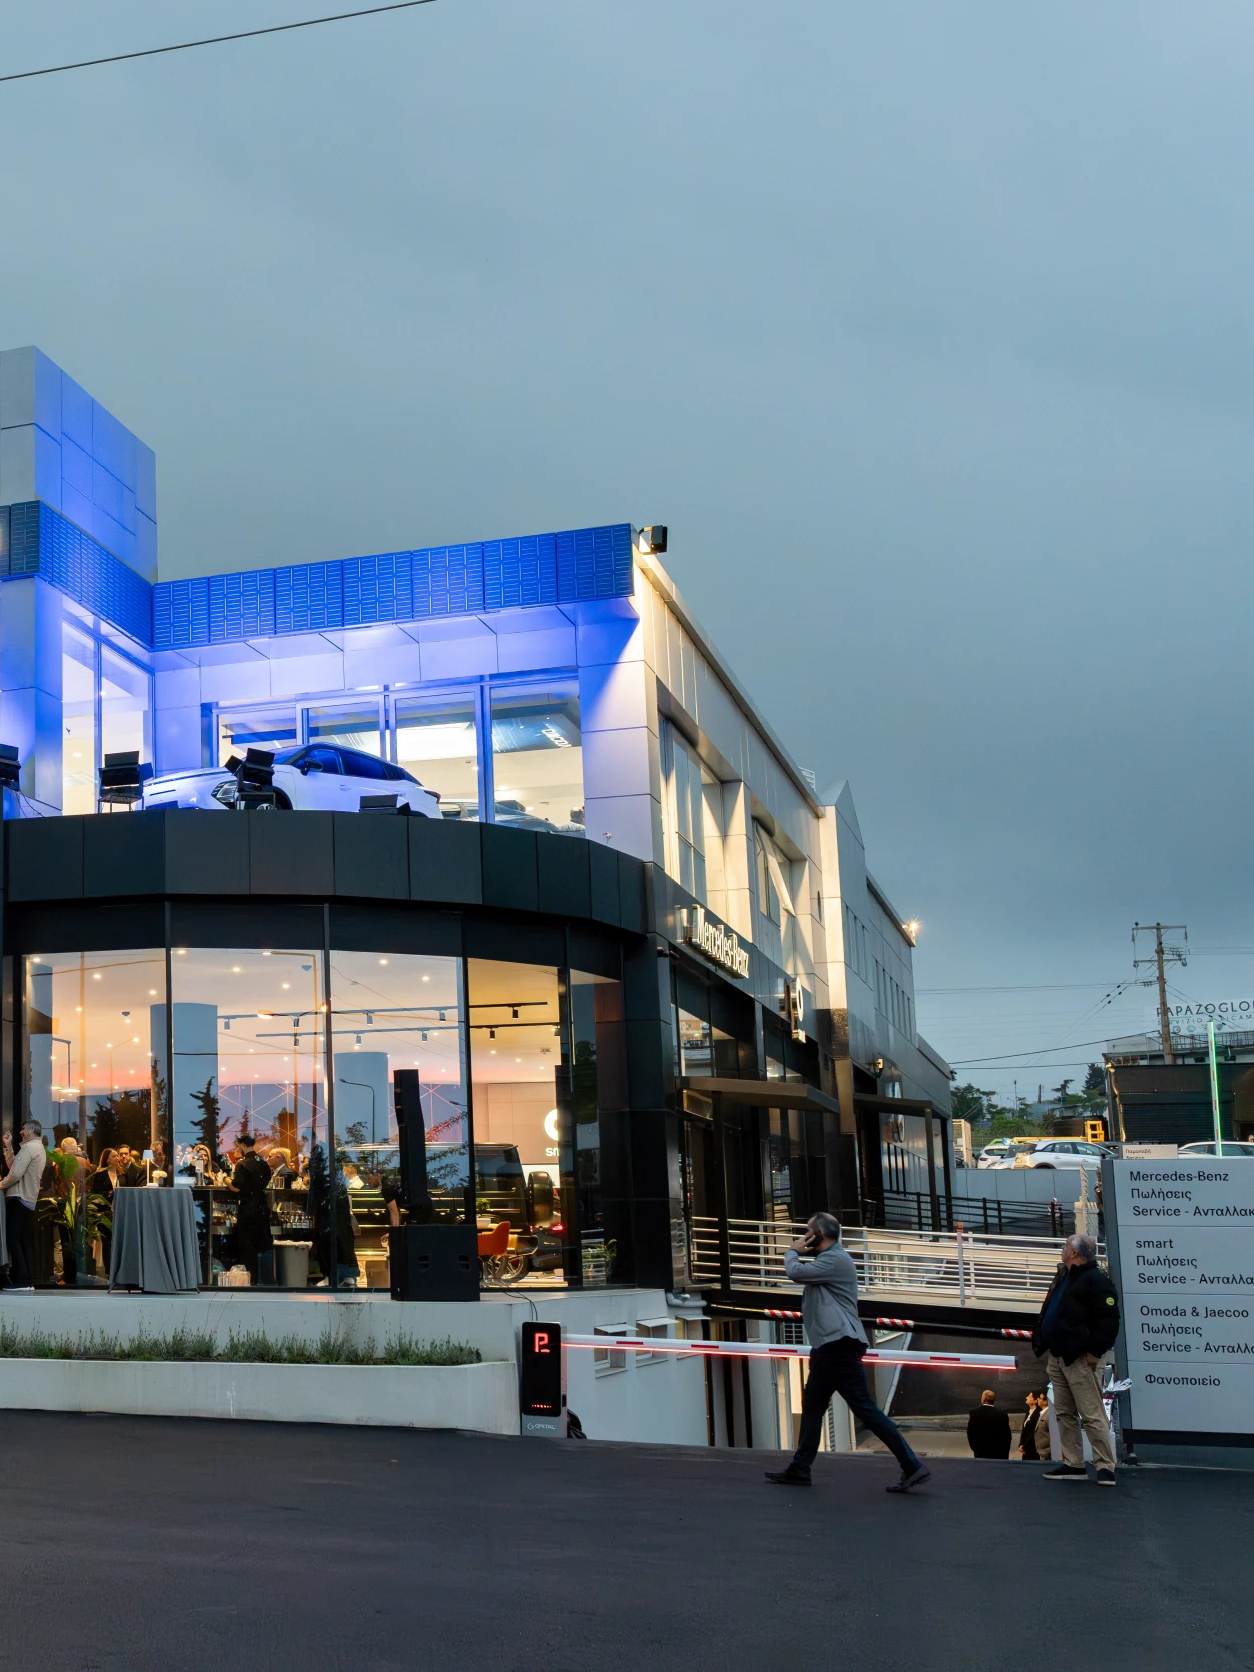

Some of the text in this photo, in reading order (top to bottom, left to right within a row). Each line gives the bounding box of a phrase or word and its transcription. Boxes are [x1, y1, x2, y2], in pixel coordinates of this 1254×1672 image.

[692, 903, 750, 979] Mercedes-Benz
[1129, 1170, 1229, 1182] Mercedes-Benz
[1131, 1187, 1192, 1202] Πωλήσεις
[1132, 1205, 1181, 1217] Service
[1135, 1238, 1174, 1249] smart
[1136, 1254, 1198, 1269] Πωλήσεις
[1138, 1272, 1187, 1284] Service
[1199, 1273, 1254, 1285] Ανταλλα
[1140, 1305, 1249, 1319] Omoda & Jaecoo
[1141, 1322, 1203, 1338] Πωλήσεις
[1142, 1340, 1192, 1353] Service
[1144, 1373, 1221, 1387] Φανοποιείο
